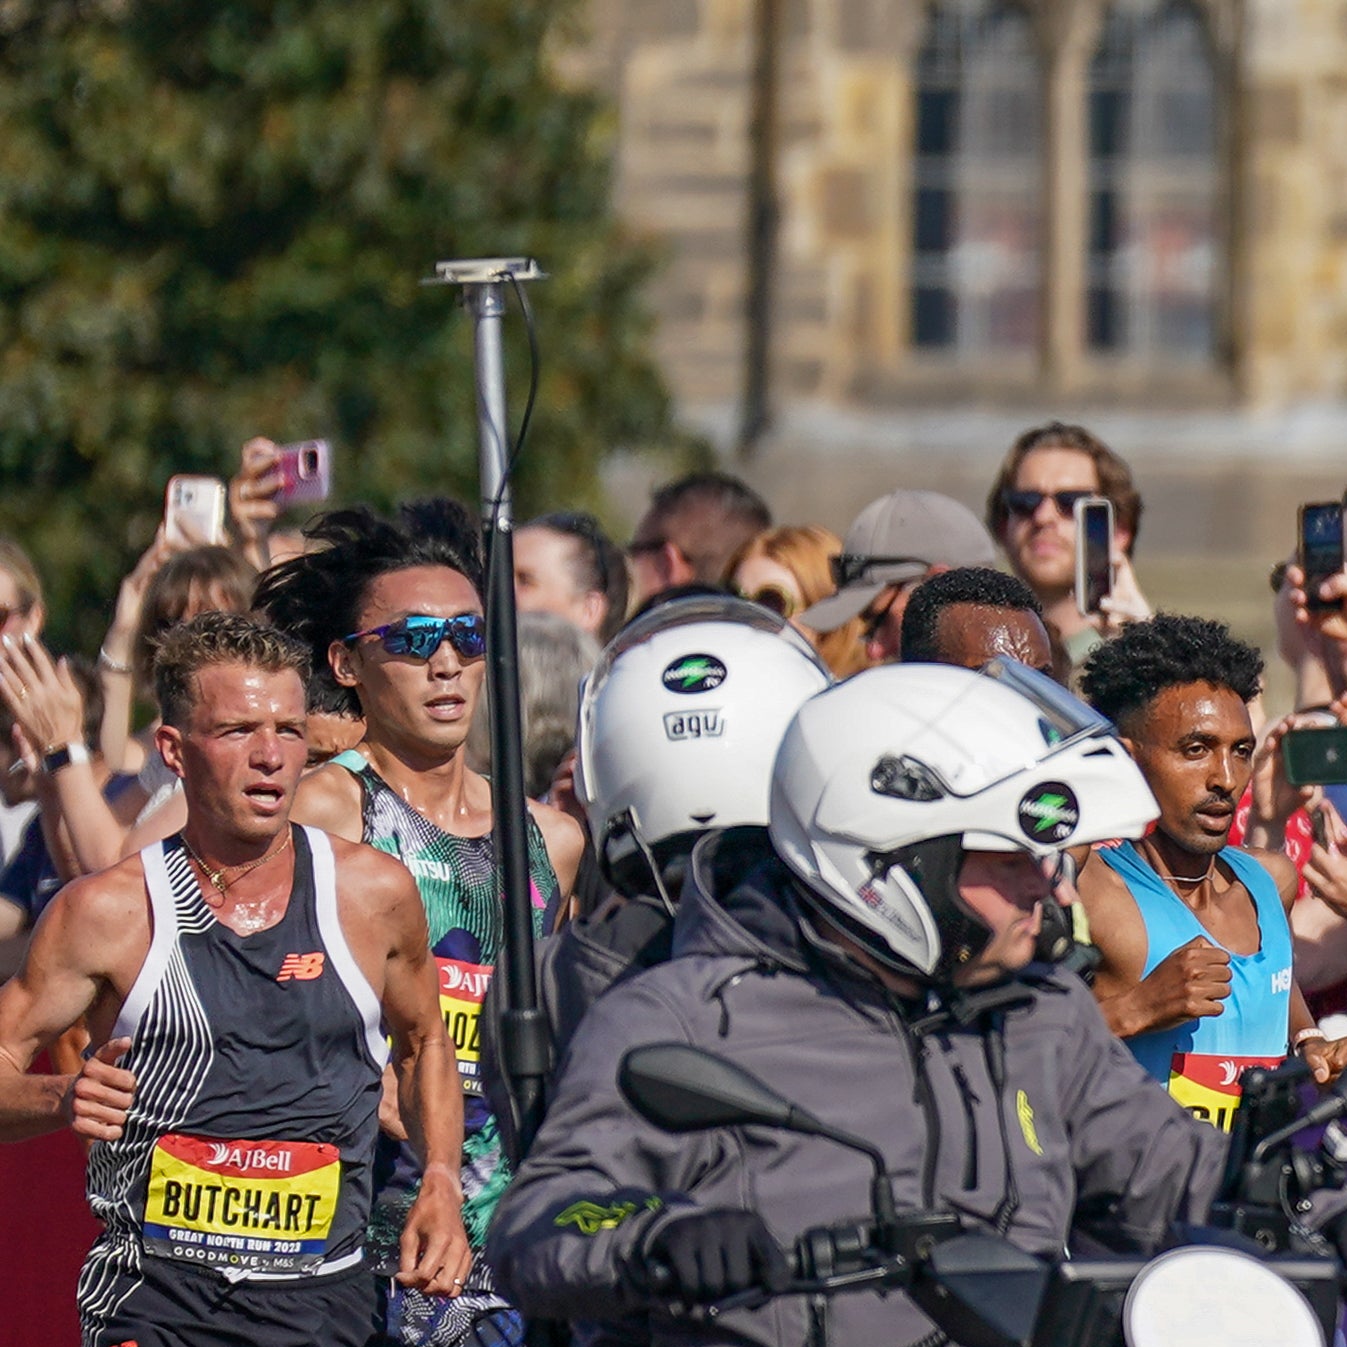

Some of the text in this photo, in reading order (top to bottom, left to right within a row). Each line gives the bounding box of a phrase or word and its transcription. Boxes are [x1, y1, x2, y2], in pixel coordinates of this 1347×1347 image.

[162, 1180, 321, 1233] BUTCHART
[168, 1229, 301, 1253] GREAT NORTH RUN 2023
[173, 1246, 258, 1266] GOODMOVE
